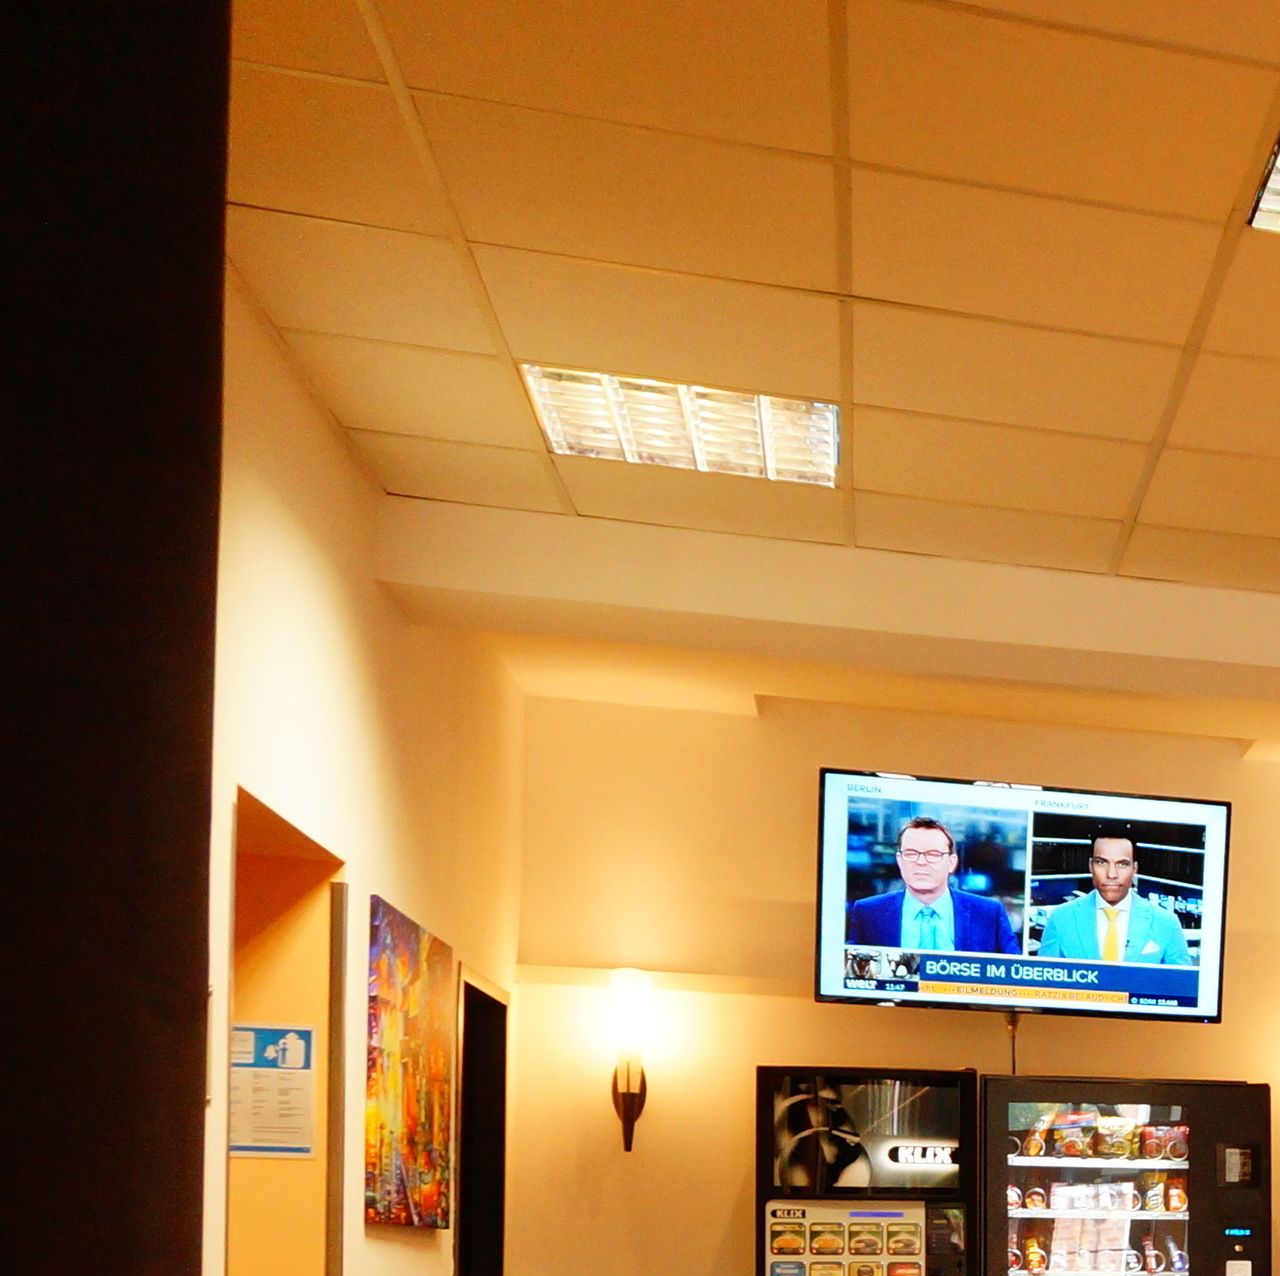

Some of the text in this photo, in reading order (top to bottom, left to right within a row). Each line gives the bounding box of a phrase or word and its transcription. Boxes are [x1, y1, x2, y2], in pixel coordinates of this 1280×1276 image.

[847, 784, 882, 793] BERLIN
[1034, 799, 1089, 810] FRANKFURT
[926, 960, 1098, 983] BÖRSE IM ÜBERBLICK
[846, 979, 877, 989] WELT
[898, 1146, 953, 1164] KLIX
[776, 1209, 803, 1218] KLIX
